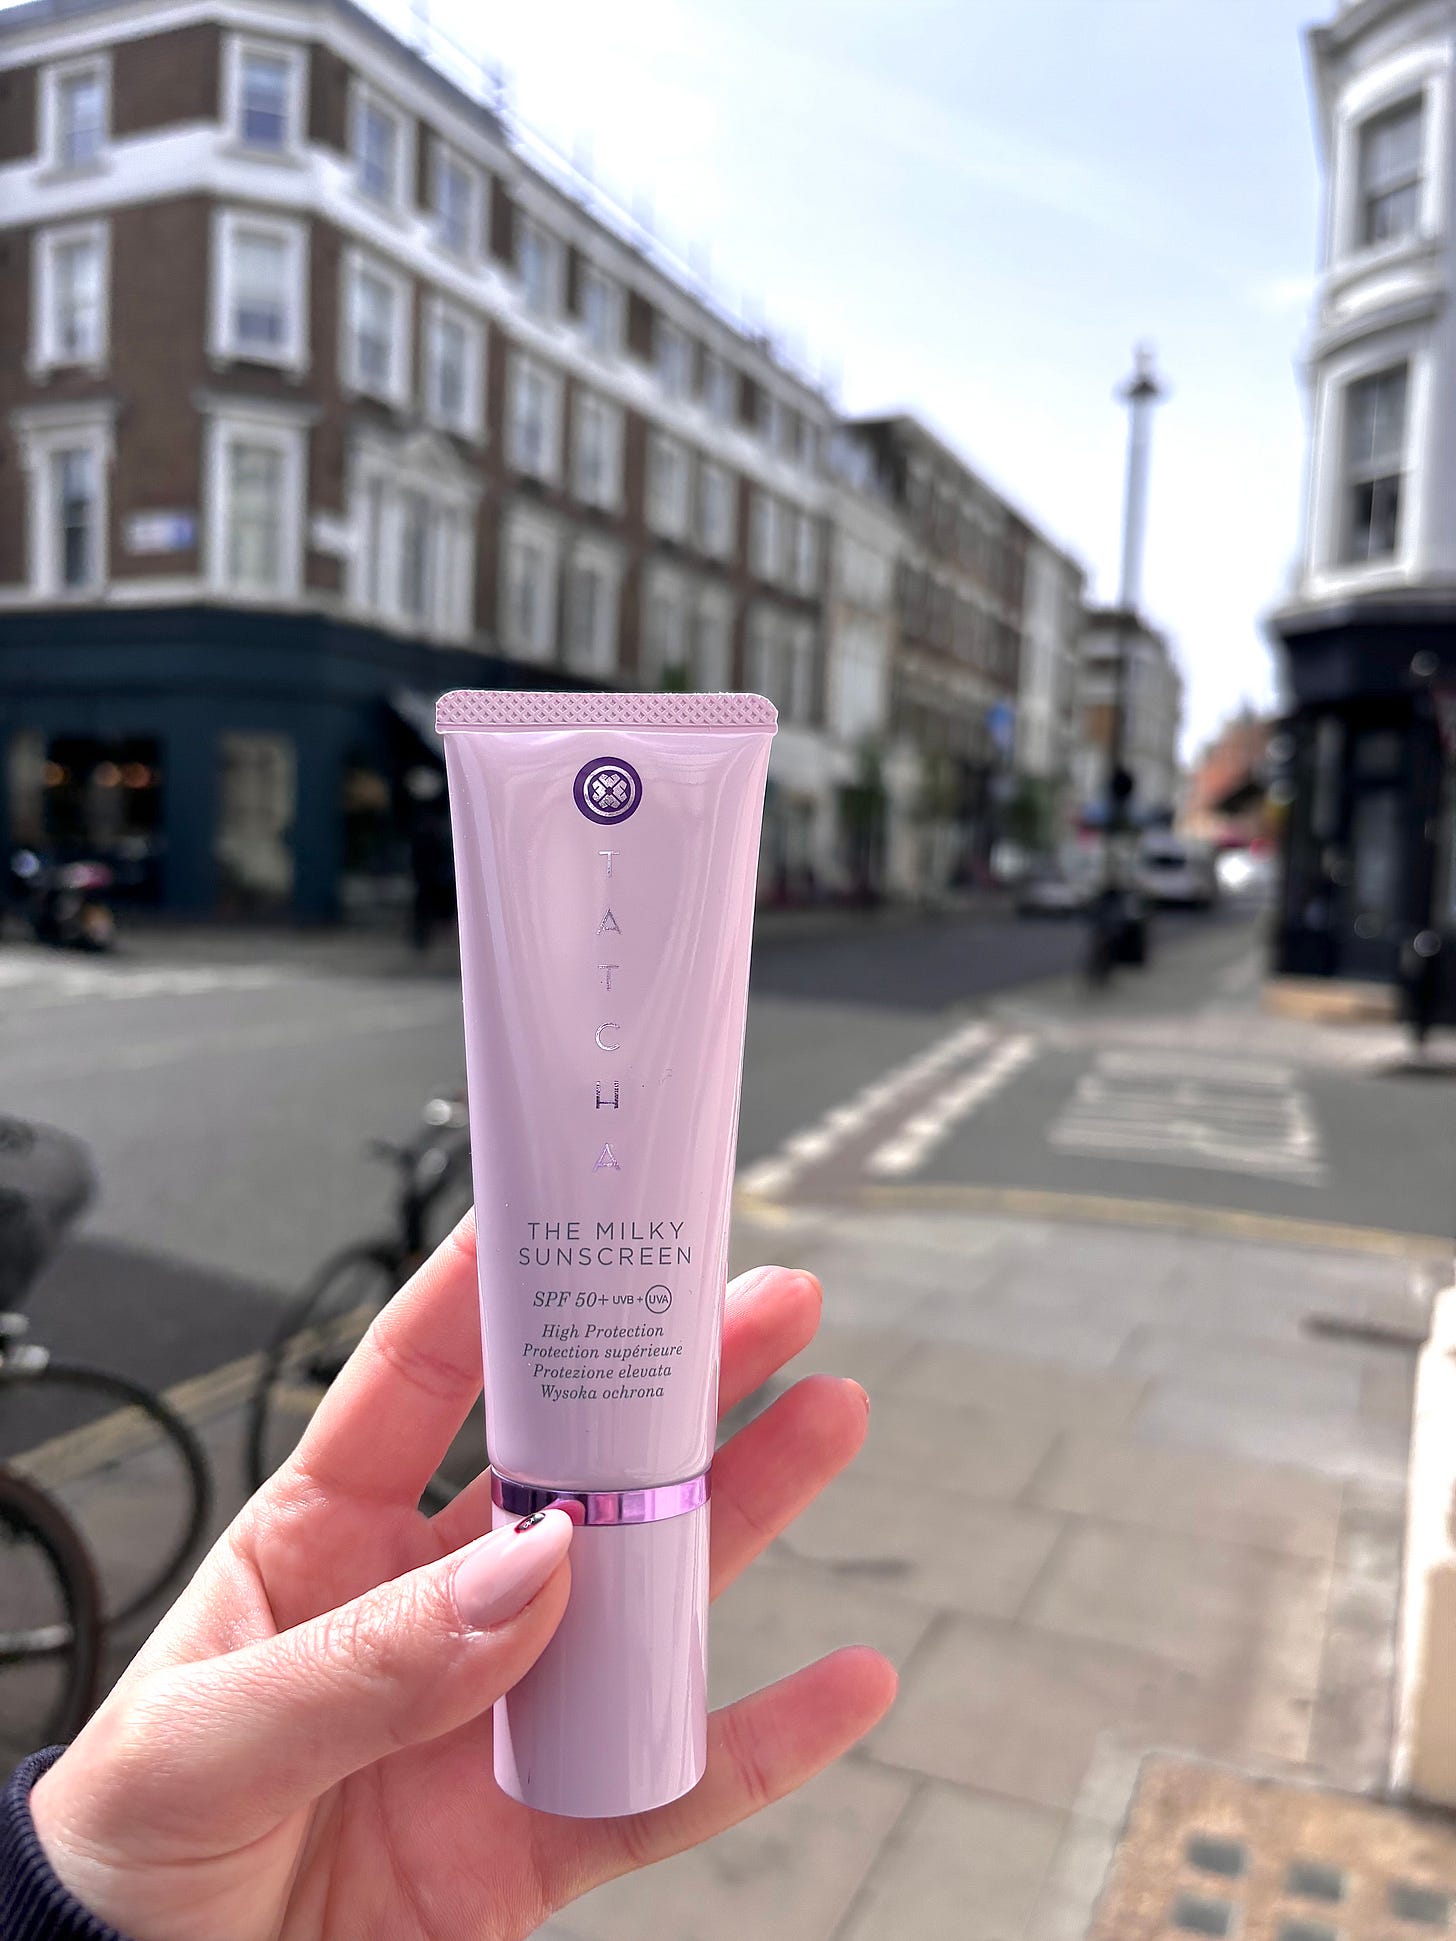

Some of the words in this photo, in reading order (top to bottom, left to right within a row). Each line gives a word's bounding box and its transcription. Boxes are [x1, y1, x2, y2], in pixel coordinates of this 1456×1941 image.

[592, 850, 623, 1172] TATCHA
[527, 1222, 581, 1240] THE
[596, 1221, 684, 1240] MILKY
[519, 1246, 691, 1266] SUNSCREEN
[533, 1291, 571, 1307] SPF
[612, 1295, 634, 1305] UVB
[649, 1295, 669, 1304] UVA
[541, 1324, 579, 1341] High
[584, 1323, 664, 1338] Protection
[522, 1343, 599, 1358] Protection
[604, 1344, 683, 1361] supérieure
[533, 1364, 613, 1379] Protezione
[618, 1364, 672, 1378] elevata
[541, 1384, 598, 1402] Wysoka
[602, 1385, 664, 1399] ochrona
